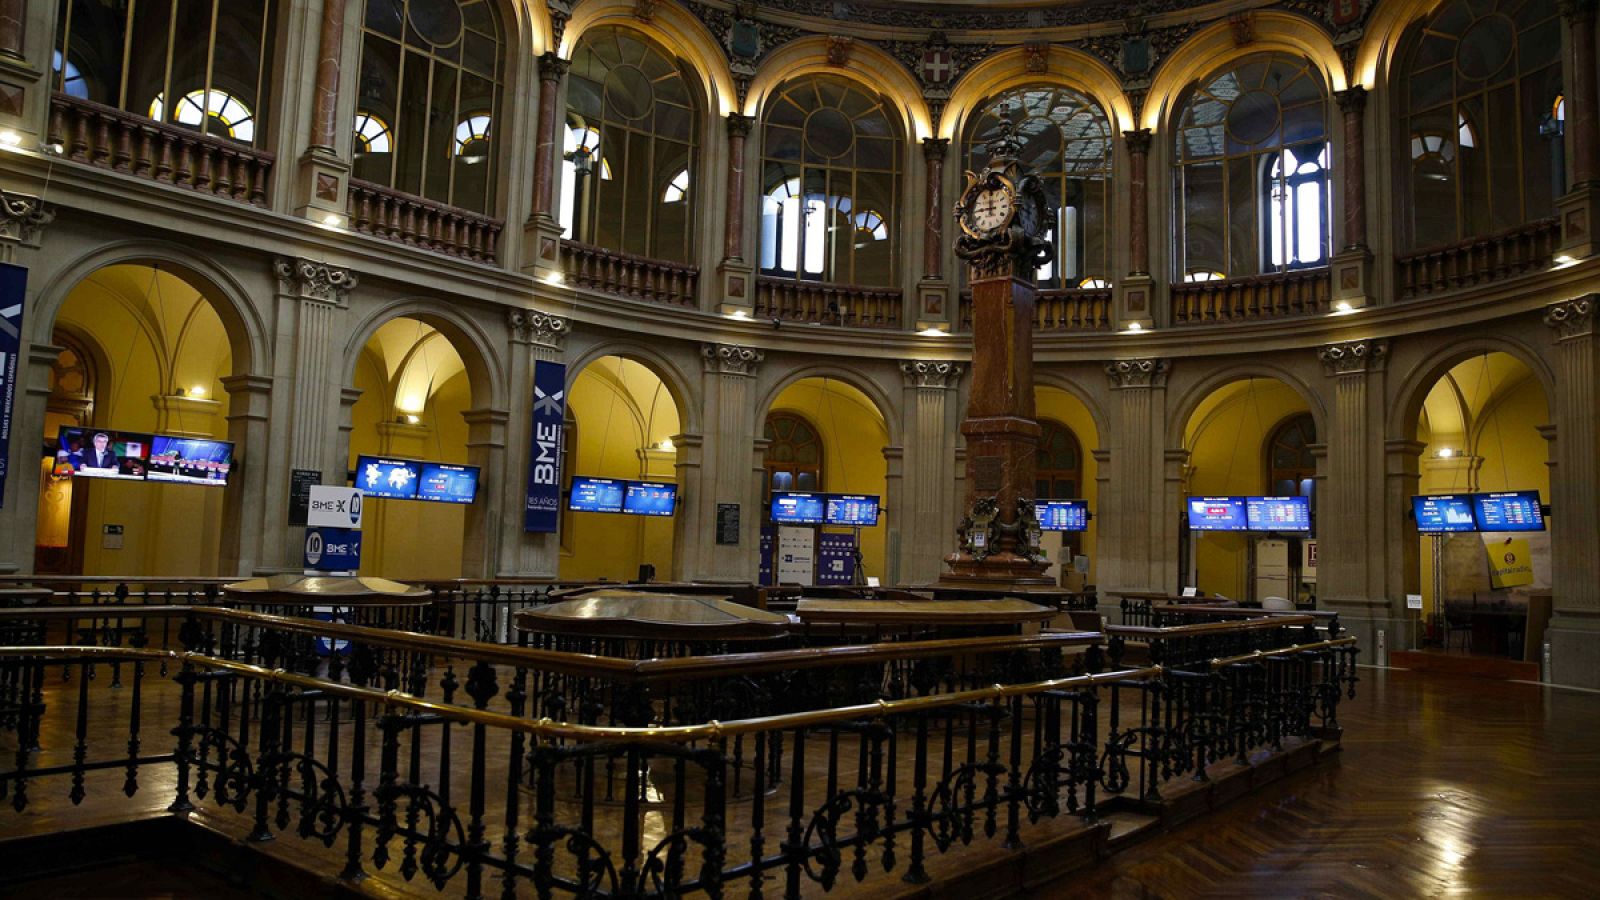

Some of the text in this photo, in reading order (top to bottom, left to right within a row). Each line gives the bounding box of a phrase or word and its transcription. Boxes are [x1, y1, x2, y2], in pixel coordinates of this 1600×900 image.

[535, 422, 557, 485] BME
[312, 500, 334, 510] BME
[310, 537, 320, 552] 10
[326, 544, 348, 553] BME
